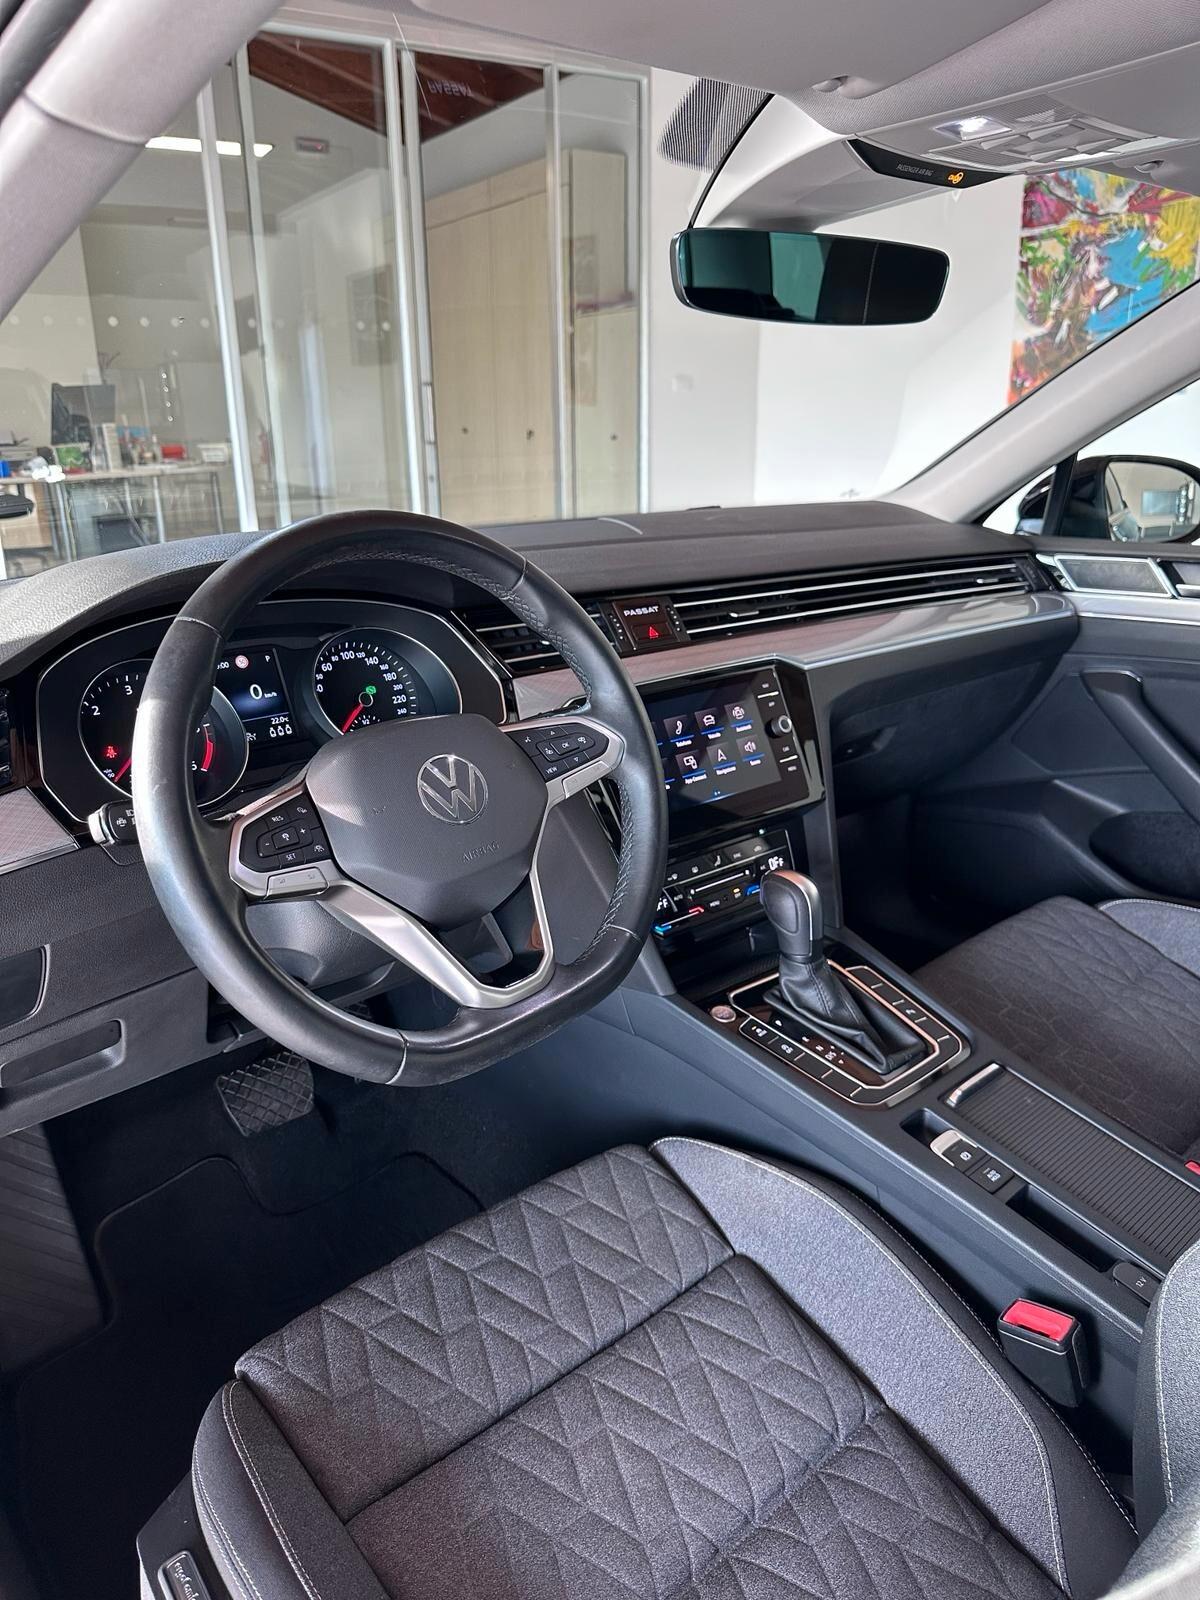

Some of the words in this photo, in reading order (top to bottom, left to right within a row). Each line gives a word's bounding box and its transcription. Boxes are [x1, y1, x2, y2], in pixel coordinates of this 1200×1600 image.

[623, 605, 659, 617] PASSAT
[340, 650, 355, 660] 100
[364, 656, 379, 666] 140
[321, 662, 333, 672] 60
[379, 663, 389, 671] 160
[383, 672, 397, 682] 180
[124, 685, 133, 695] 3
[249, 683, 263, 700] 0
[393, 683, 403, 691] 200
[391, 696, 407, 704] 220
[91, 705, 101, 716] 2
[545, 766, 558, 774] VIEW
